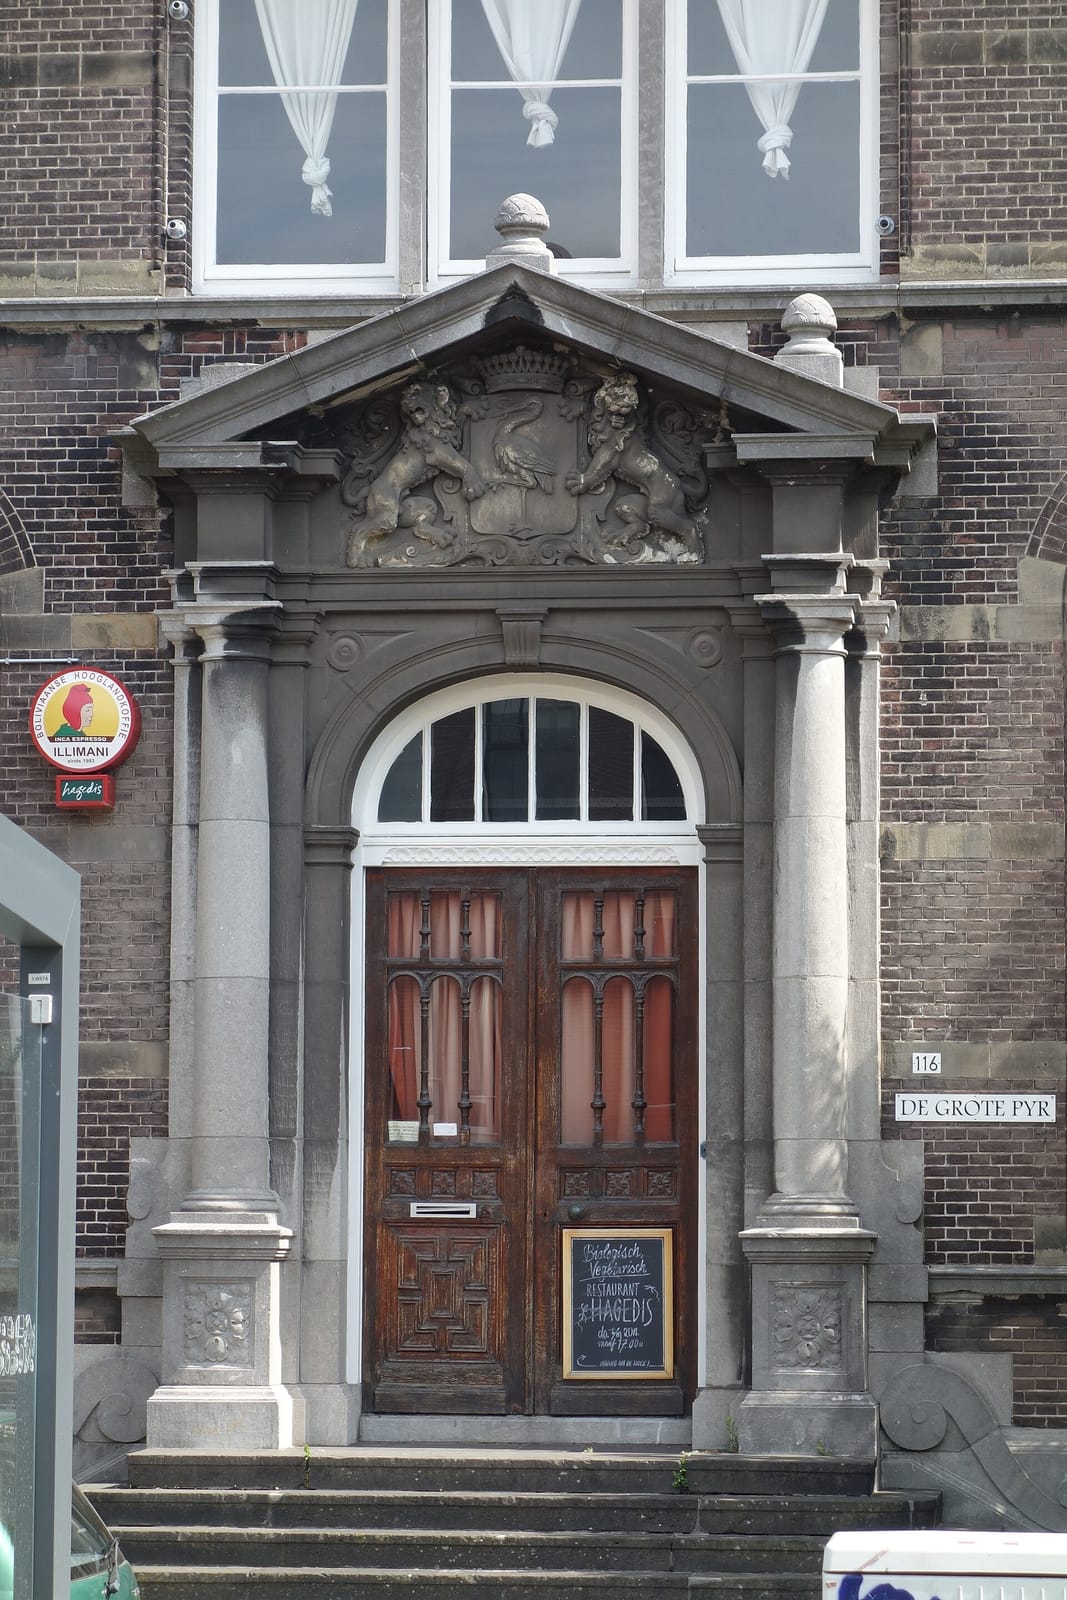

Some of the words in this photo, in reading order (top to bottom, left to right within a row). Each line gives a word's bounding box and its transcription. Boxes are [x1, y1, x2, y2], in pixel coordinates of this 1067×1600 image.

[35, 676, 67, 739] BOLIVIAANSE
[74, 671, 130, 740] HOOGLANDKOFFIE
[54, 747, 109, 757] ILLIMANI
[61, 782, 102, 801] hagedis
[915, 1055, 938, 1072] 116
[900, 1099, 929, 1116] DE
[935, 1099, 1005, 1117] GROTE
[1012, 1099, 1050, 1117] PYR
[589, 1259, 647, 1282] Vegetarisch
[586, 1282, 640, 1297] RESTAURANT
[591, 1297, 653, 1326] HAGEDIS
